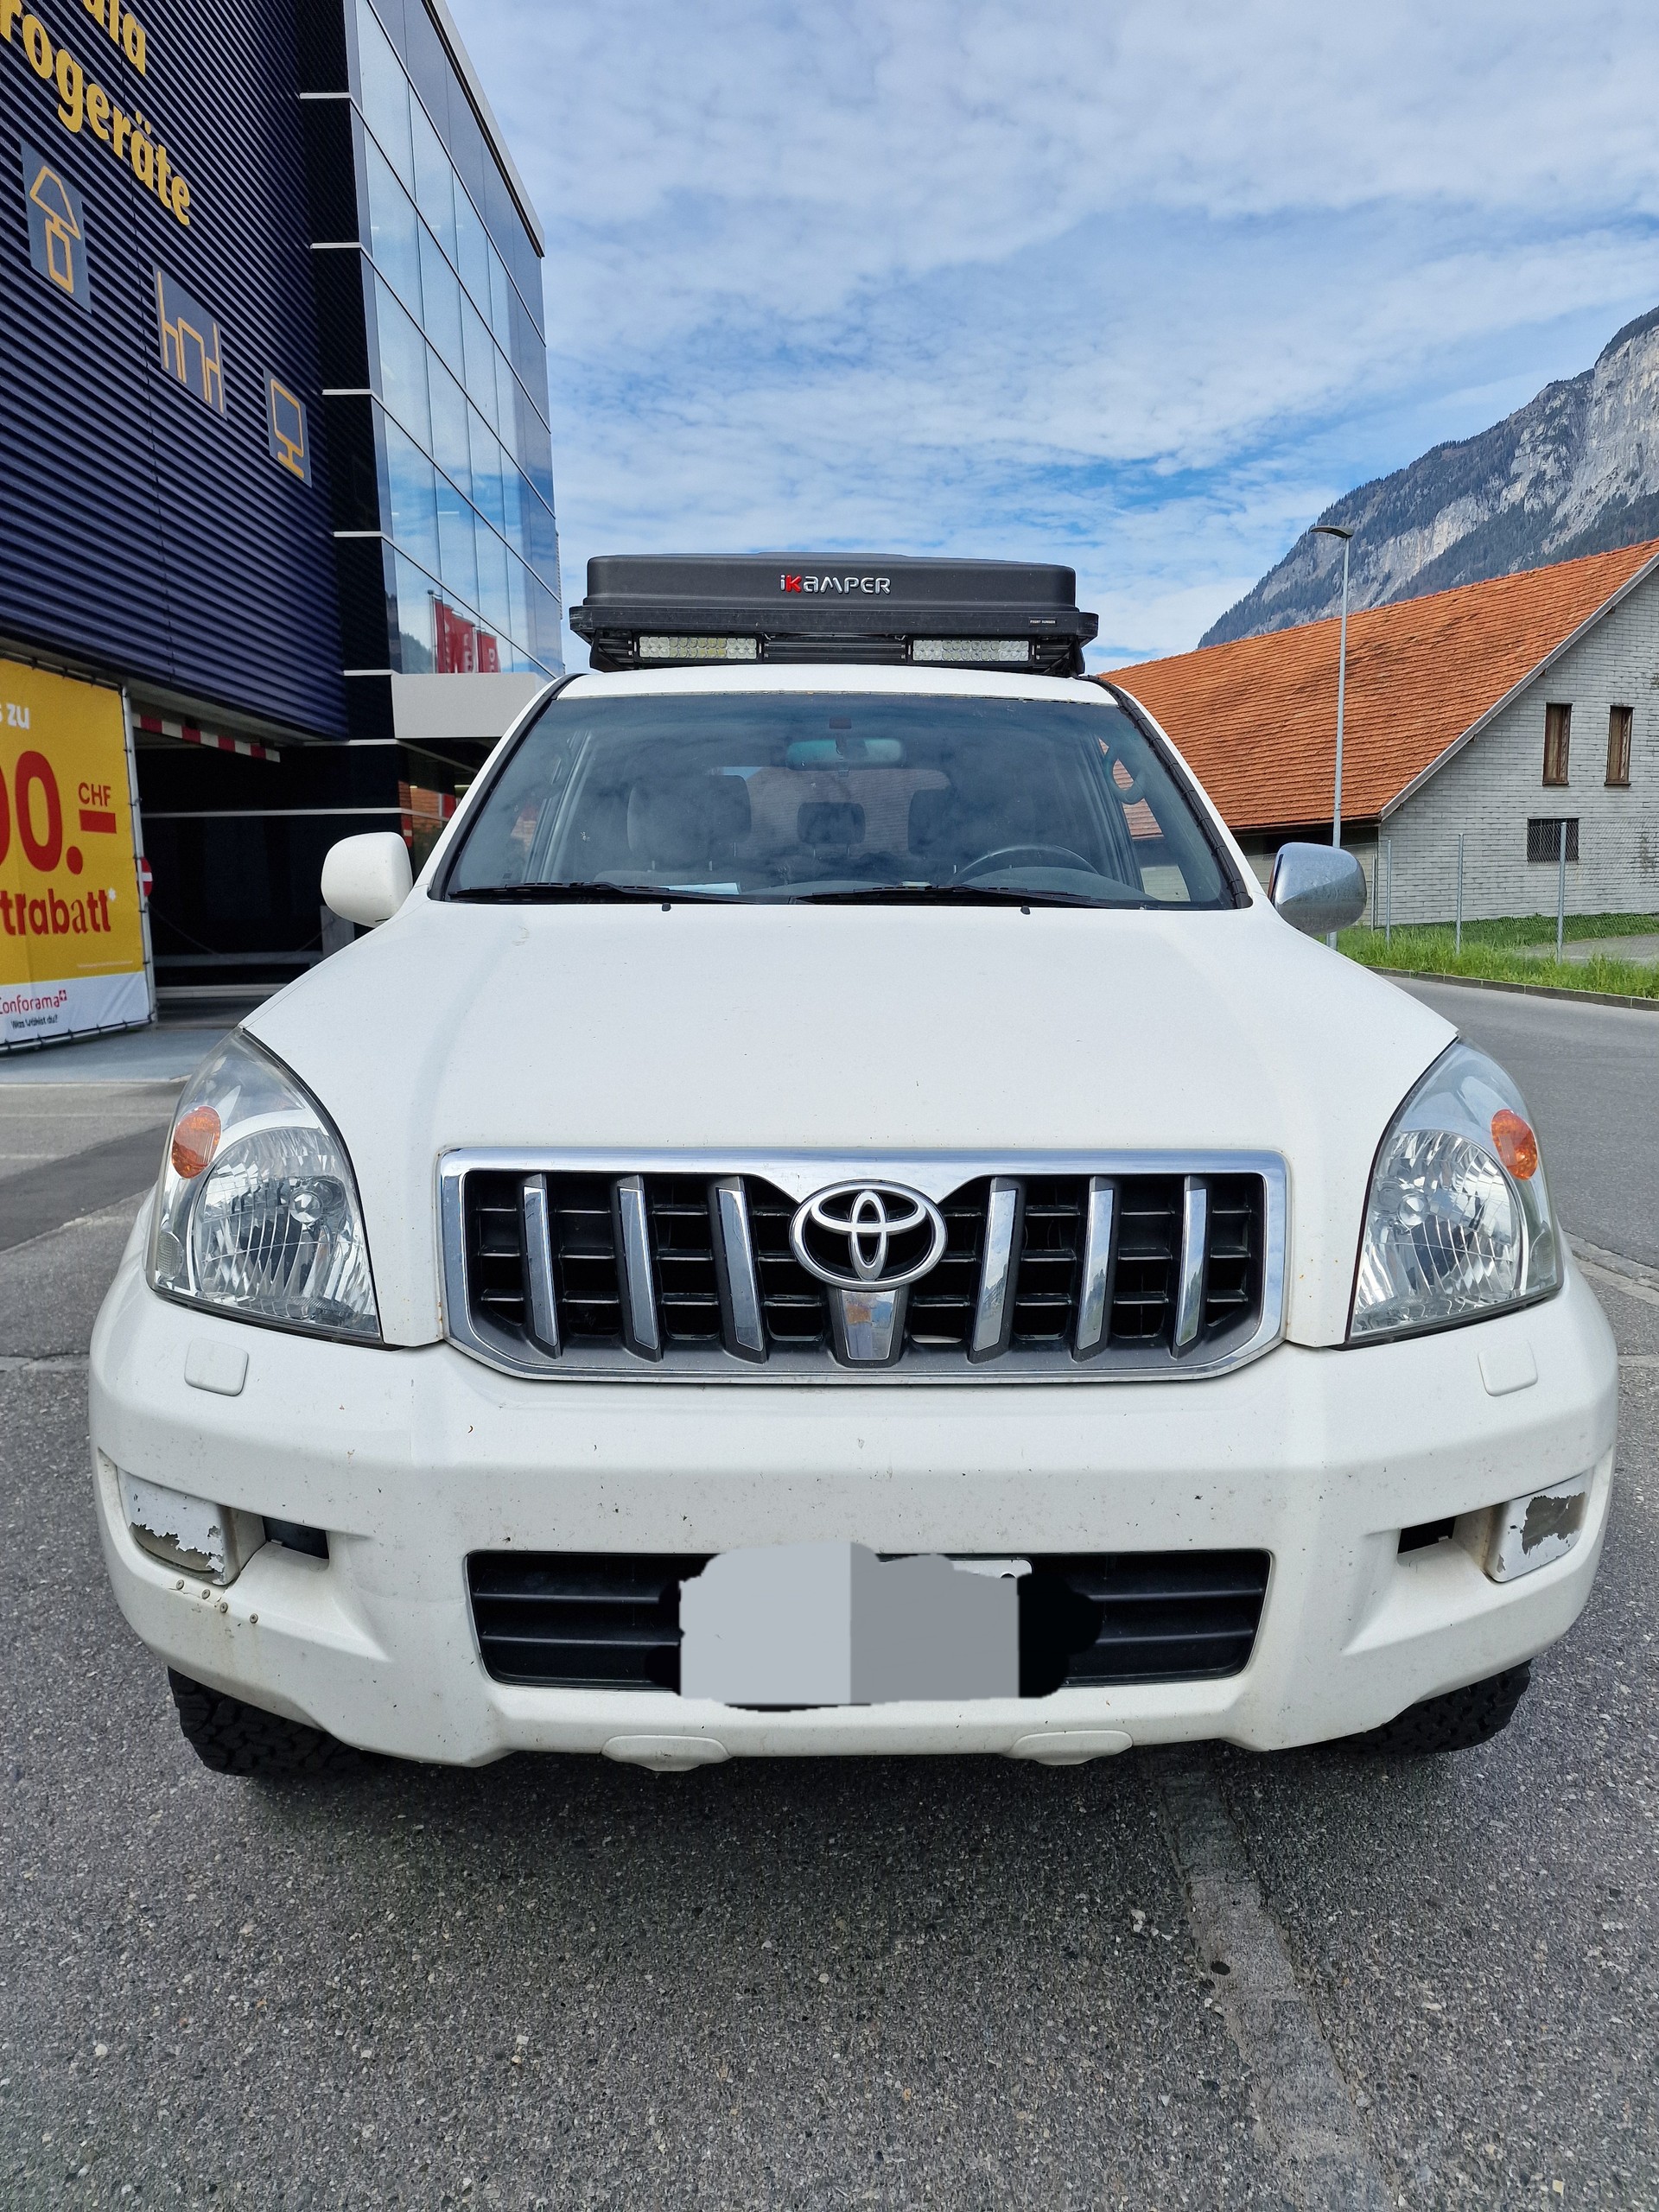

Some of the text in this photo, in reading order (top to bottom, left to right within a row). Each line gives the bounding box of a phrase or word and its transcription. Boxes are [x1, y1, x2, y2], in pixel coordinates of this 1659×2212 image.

[6, 702, 30, 730] zu
[78, 782, 111, 807] CHF
[0, 995, 60, 1014] onforama
